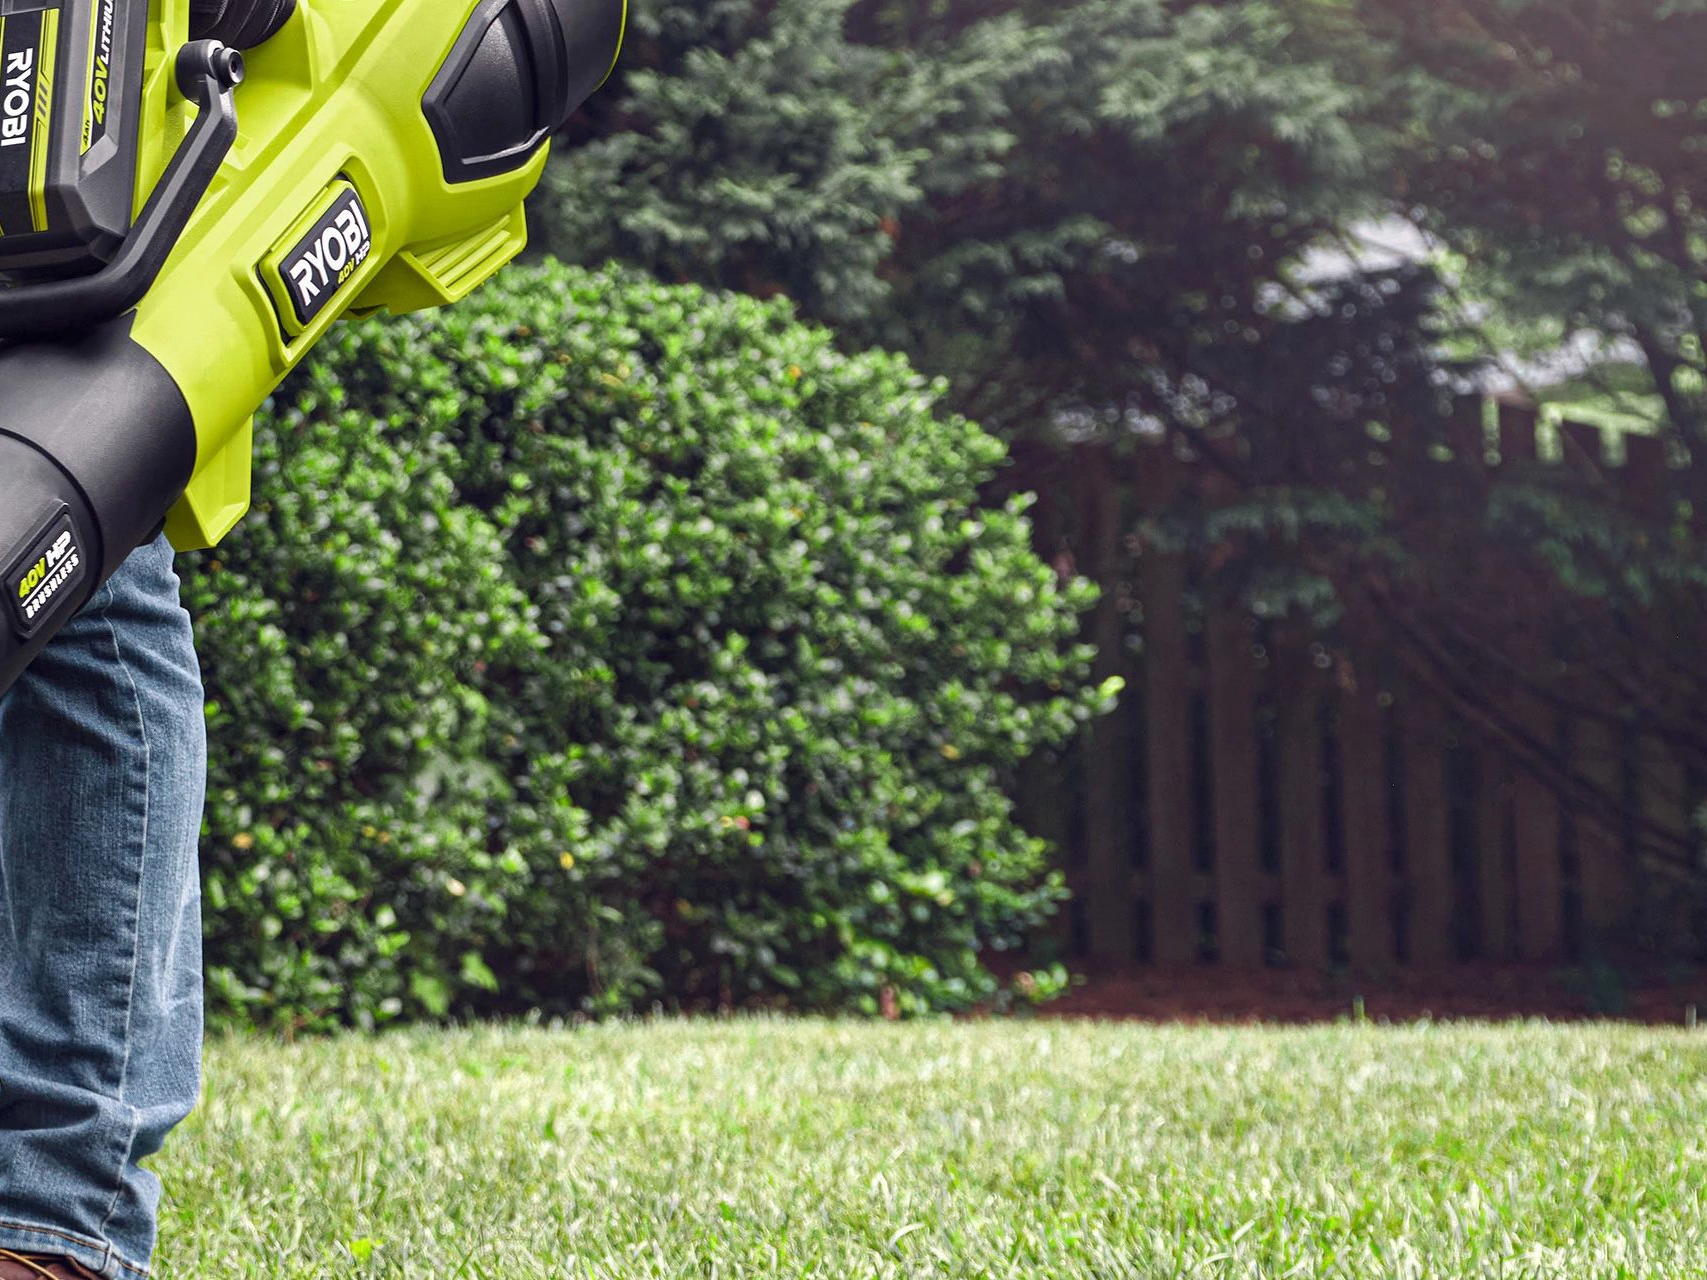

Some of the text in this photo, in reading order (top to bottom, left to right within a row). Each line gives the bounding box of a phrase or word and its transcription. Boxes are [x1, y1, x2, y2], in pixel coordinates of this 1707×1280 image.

[1, 48, 33, 146] RYOBI
[289, 199, 368, 307] RYOBI
[338, 240, 371, 284] 40V HP
[18, 531, 71, 598] 40V HP
[26, 554, 79, 618] BRUSHLESS
